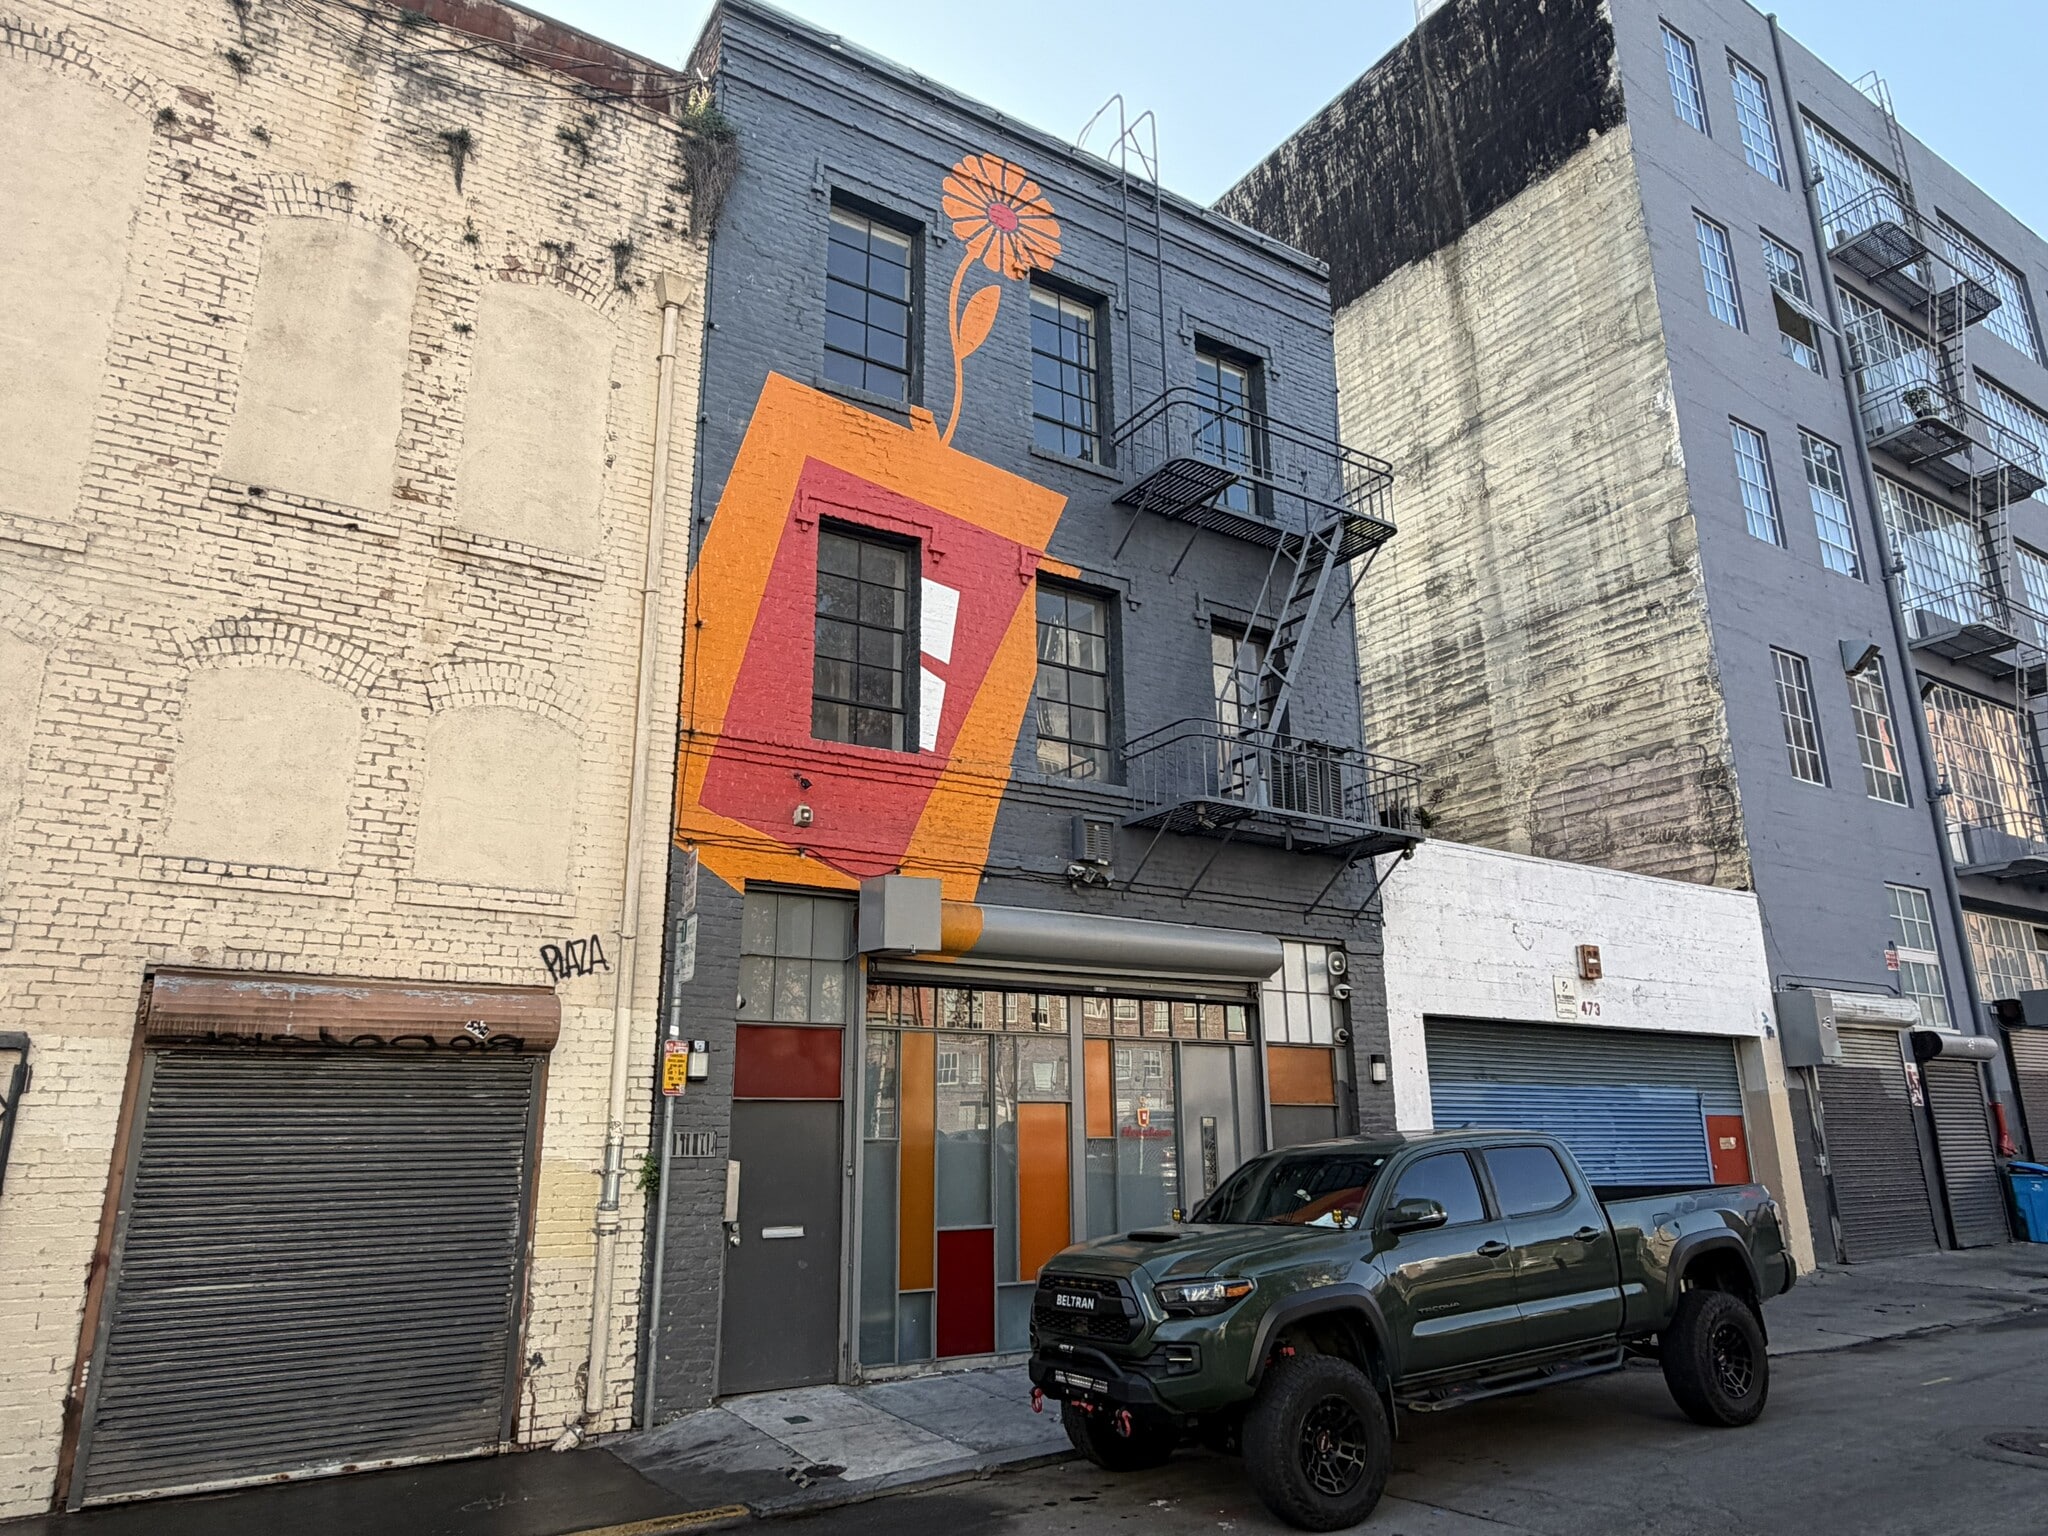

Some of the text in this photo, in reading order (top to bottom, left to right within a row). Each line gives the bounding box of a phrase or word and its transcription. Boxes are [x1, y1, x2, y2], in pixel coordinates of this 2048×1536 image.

[540, 934, 610, 984] PLAZA
[1581, 1001, 1601, 1016] 473
[1056, 1294, 1095, 1310] BELTRAN
